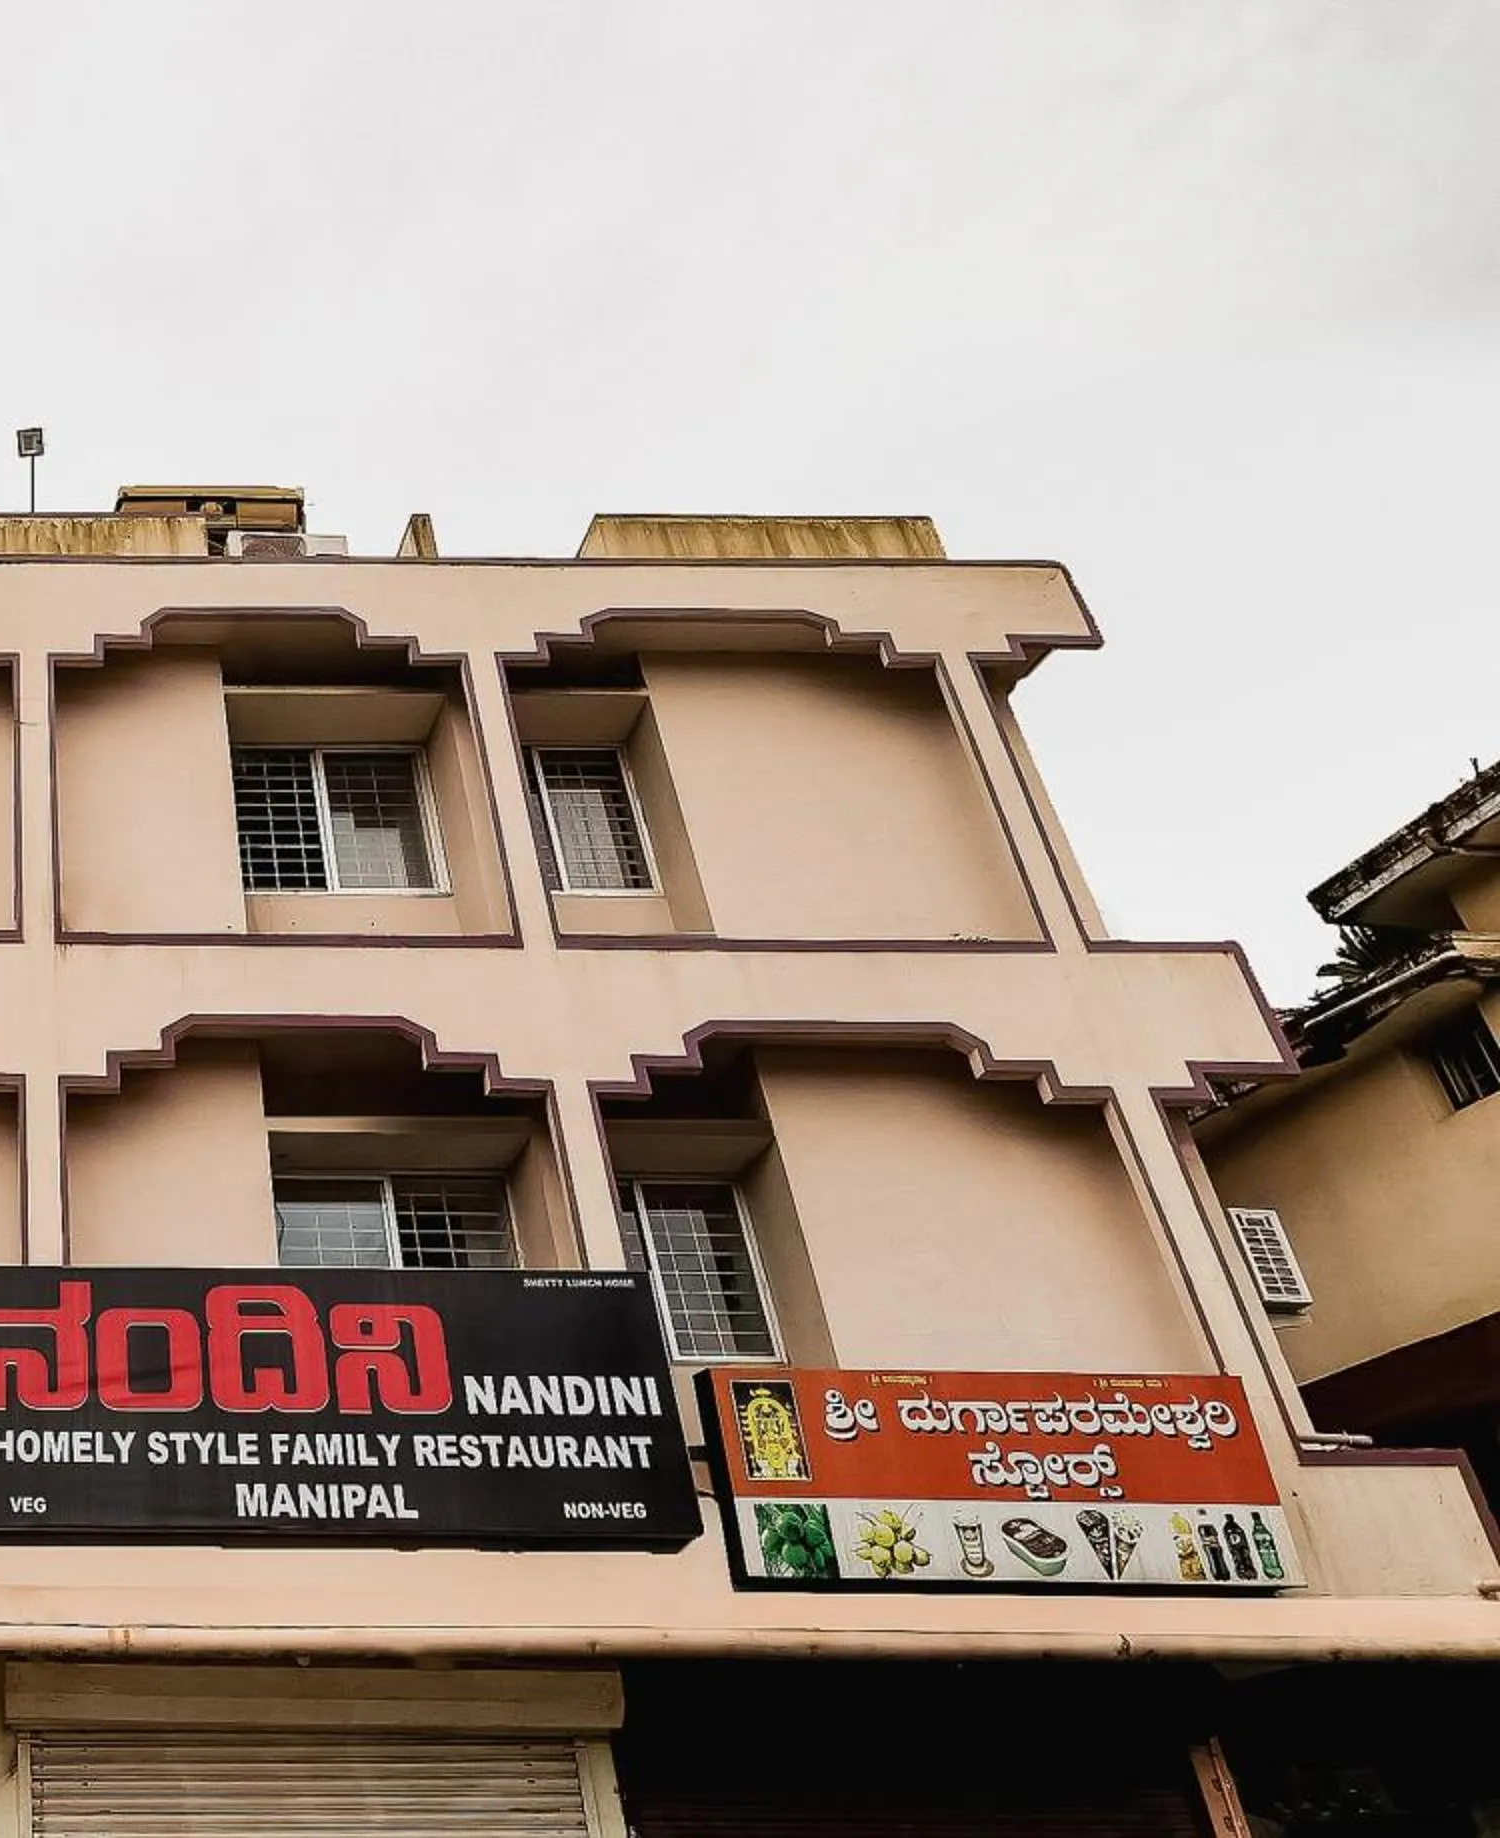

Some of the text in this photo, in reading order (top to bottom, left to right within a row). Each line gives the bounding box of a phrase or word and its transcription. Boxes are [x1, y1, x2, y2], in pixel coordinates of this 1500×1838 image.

[462, 1374, 663, 1417] NANDINI
[824, 1389, 1239, 1450] ಶ್ರೀ ದುರ್ಗಾಪರಮೇಶ್ವರಿ
[147, 1432, 261, 1465] STYLE
[271, 1432, 402, 1468] FAMILY
[413, 1434, 653, 1469] RESTAURANT
[9, 1496, 48, 1514] VEG
[235, 1482, 420, 1520] MANIPAL
[563, 1502, 648, 1520] NON-VEG
